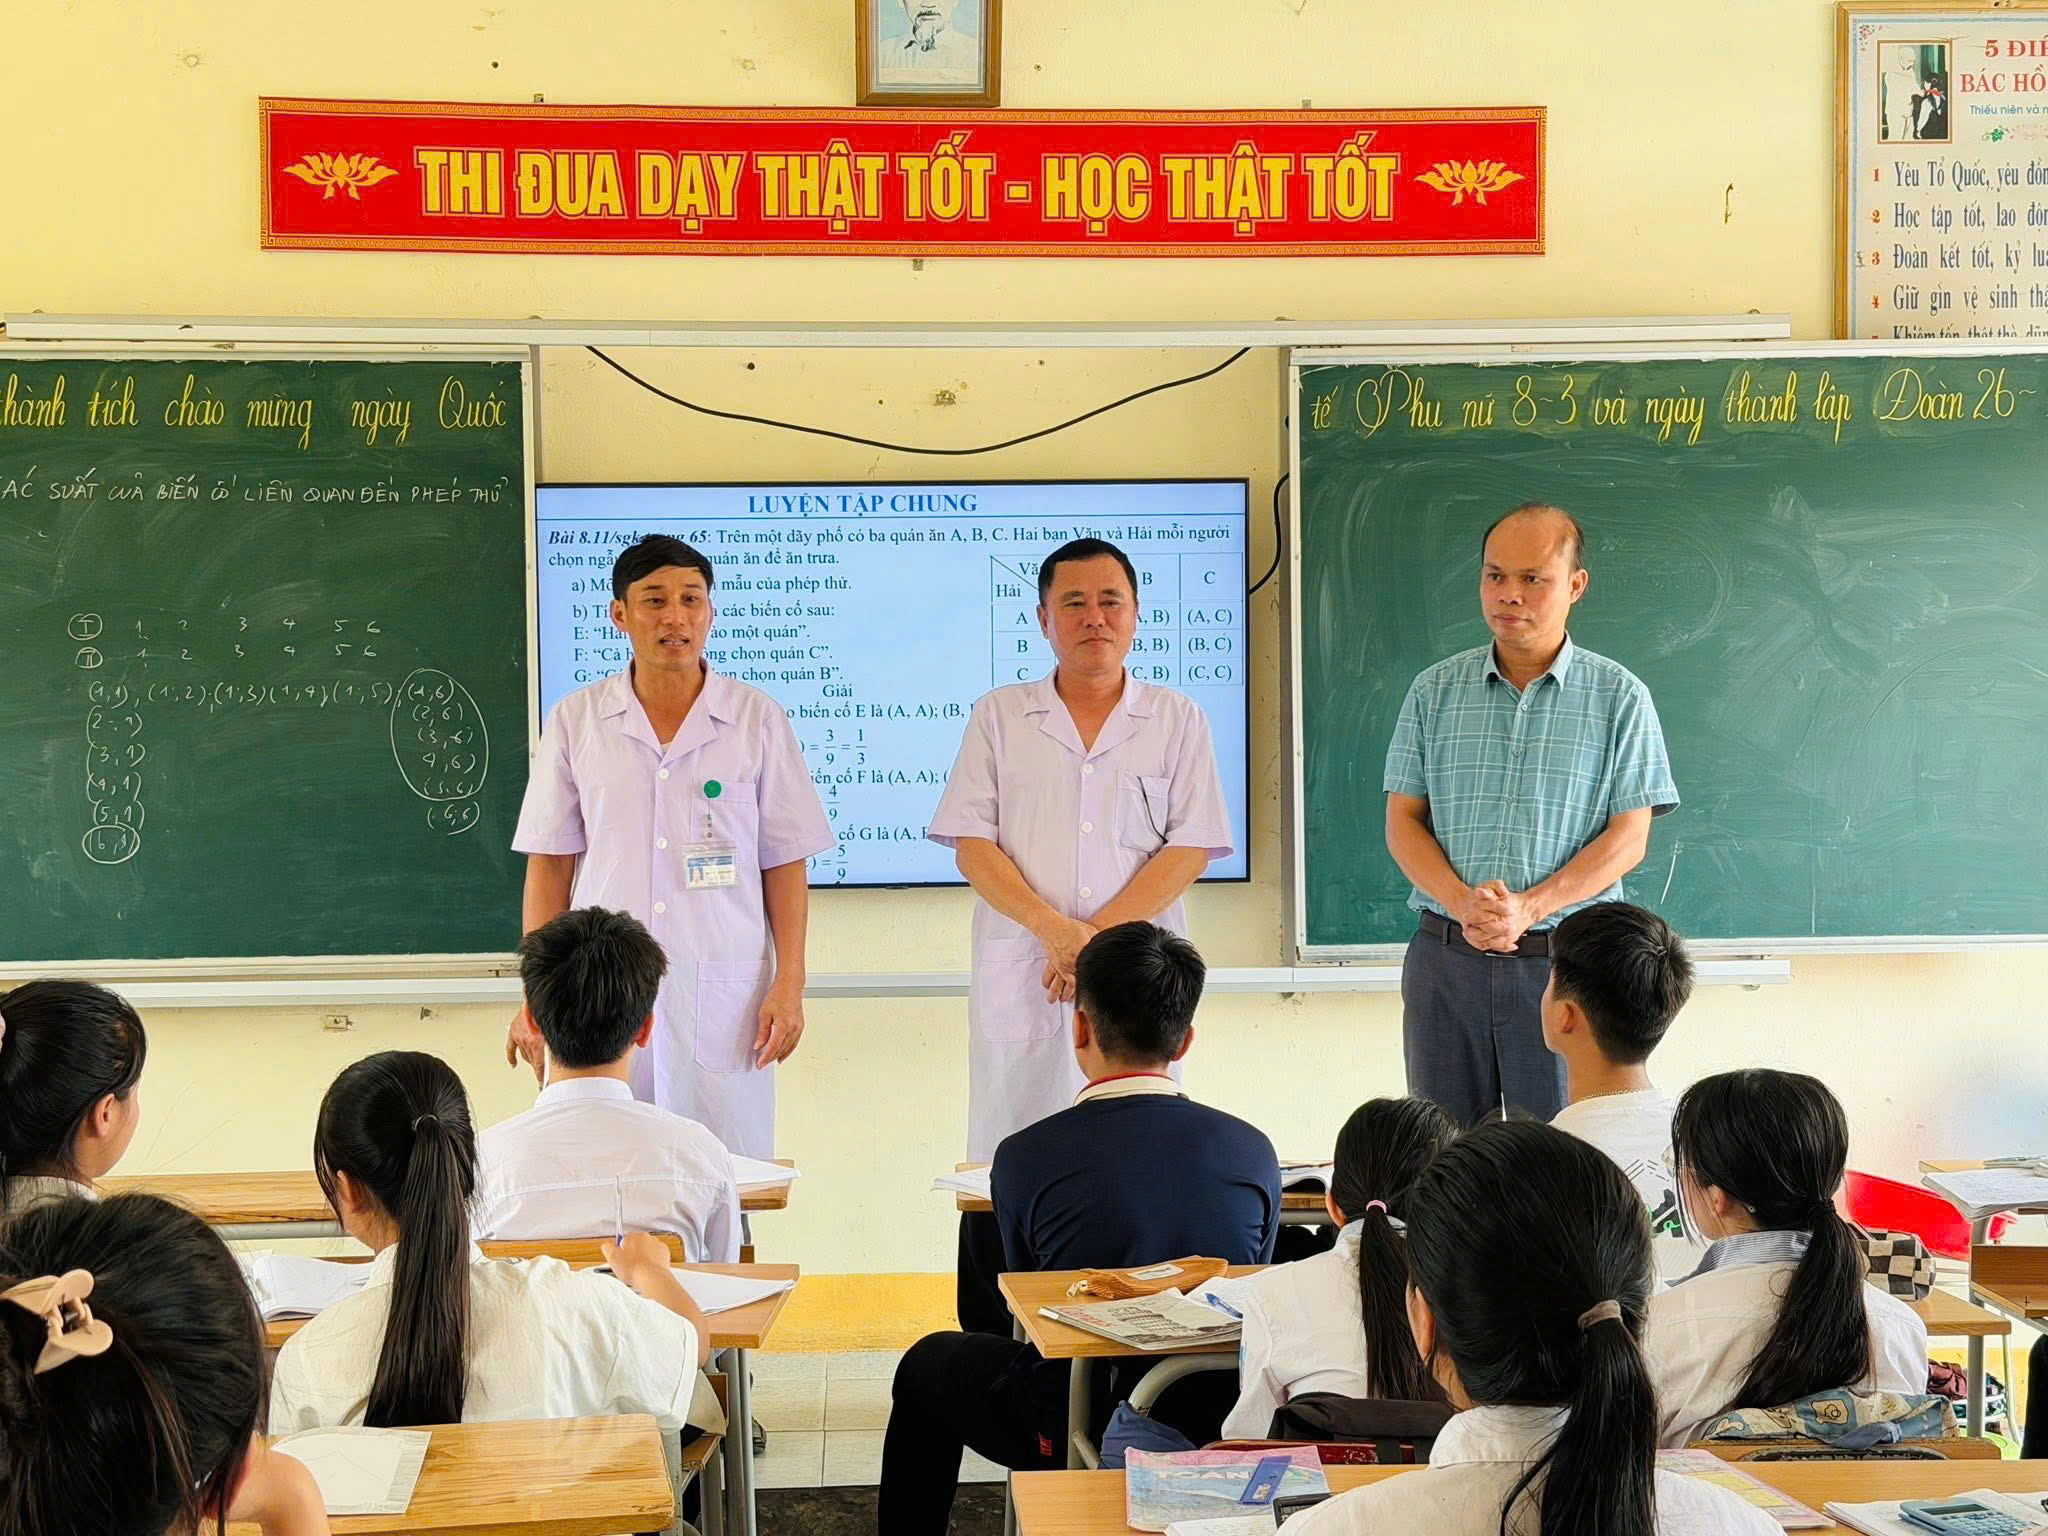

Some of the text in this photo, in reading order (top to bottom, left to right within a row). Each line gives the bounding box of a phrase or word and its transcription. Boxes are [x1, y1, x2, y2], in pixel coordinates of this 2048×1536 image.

[1985, 40, 1999, 57] 5
[1960, 64, 2046, 92] BÁC HỒ
[1970, 104, 2039, 115] Thiếu niên và
[1873, 169, 1880, 182] 1
[1894, 161, 1920, 187] Yêu
[1928, 156, 1945, 187] Tổ
[1952, 159, 1990, 192] Quốc,
[1997, 162, 2019, 192] yêu
[416, 149, 502, 217] THI
[516, 150, 625, 218] ĐUA
[638, 151, 740, 233] DẠY
[756, 139, 885, 234] THẬT
[899, 131, 995, 221] TỐT
[1042, 154, 1151, 235] HỌC
[1162, 141, 1293, 236] THẬT
[1303, 131, 1399, 221] TỐT
[1872, 200, 2016, 234] 2 Học tập tốt, lao
[1872, 240, 2021, 273] 3 Đoàn kết tốt, kỷ
[1872, 282, 2018, 316] 4 Giữ gìn vệ sinh
[0, 373, 506, 450] hành tích chào mừng ngày Quốc
[1310, 385, 1339, 429] tế
[1356, 369, 1443, 440] Phụ
[1463, 393, 1495, 427] nữ
[1594, 389, 1627, 426] và
[1645, 385, 1705, 447] ngày
[1725, 371, 1797, 423] thành
[1812, 371, 1851, 444] lập
[1880, 368, 1965, 421] Đoàn
[50, 467, 99, 499] SUẤT
[157, 474, 198, 499] BIẾN
[245, 480, 292, 502] LIÊN
[303, 487, 354, 501] QUAN
[361, 476, 399, 503] ĐẾN
[411, 478, 461, 503] PHÉP
[749, 493, 978, 517] LUYỆN TẬP CHUNG
[548, 531, 575, 544] Bài
[690, 531, 712, 543] 65:
[717, 529, 749, 543] Trên
[755, 529, 782, 545] một
[787, 528, 812, 545] dãy
[817, 526, 844, 545] phố
[848, 529, 864, 542] có
[869, 528, 885, 542] ba
[890, 527, 925, 546] quán
[929, 527, 945, 541] ăn
[950, 527, 967, 545] A,
[972, 527, 988, 544] B,
[992, 527, 1008, 541] C.
[1013, 526, 1038, 541] Hai
[1043, 525, 1068, 542] bạn
[1106, 525, 1123, 540] và
[1127, 524, 1152, 540] Hải
[1157, 522, 1184, 540] mỗi
[1188, 524, 1230, 544] người
[549, 548, 839, 568] chọn ăn để ăn trưa.
[572, 578, 585, 593] a)
[721, 573, 752, 590] mẫu
[756, 577, 781, 589] của
[785, 576, 820, 592] phép
[825, 575, 852, 589] thử.
[1142, 572, 1216, 585] B C
[996, 583, 1021, 598] Hải
[573, 600, 835, 621] b) các biến cố sau:
[1016, 613, 1029, 625] A
[1152, 610, 1170, 626] B)
[1188, 609, 1233, 626] (A, C)
[574, 627, 588, 639] E:
[732, 625, 759, 640] một
[1017, 641, 1028, 653] B
[1152, 637, 1170, 654] B)
[1188, 637, 1233, 654] (B, C)
[574, 647, 804, 663] F: chọn quán
[574, 668, 814, 683] G: chọn quán
[1017, 668, 1028, 681] C
[1152, 666, 1170, 682] B)
[1188, 666, 1233, 682] (C, C)
[823, 684, 852, 697] Giải
[800, 701, 830, 718] biến
[834, 701, 850, 718] cố
[856, 705, 866, 717] E
[871, 704, 883, 717] là
[887, 704, 911, 720] (A,
[915, 704, 938, 720] A);
[943, 703, 965, 719] (B,
[826, 729, 834, 741] 3
[836, 768, 939, 786] cố F là (A, A);
[839, 825, 854, 840] cố
[860, 827, 872, 840] G
[877, 827, 889, 840] là
[894, 827, 917, 842] (A,
